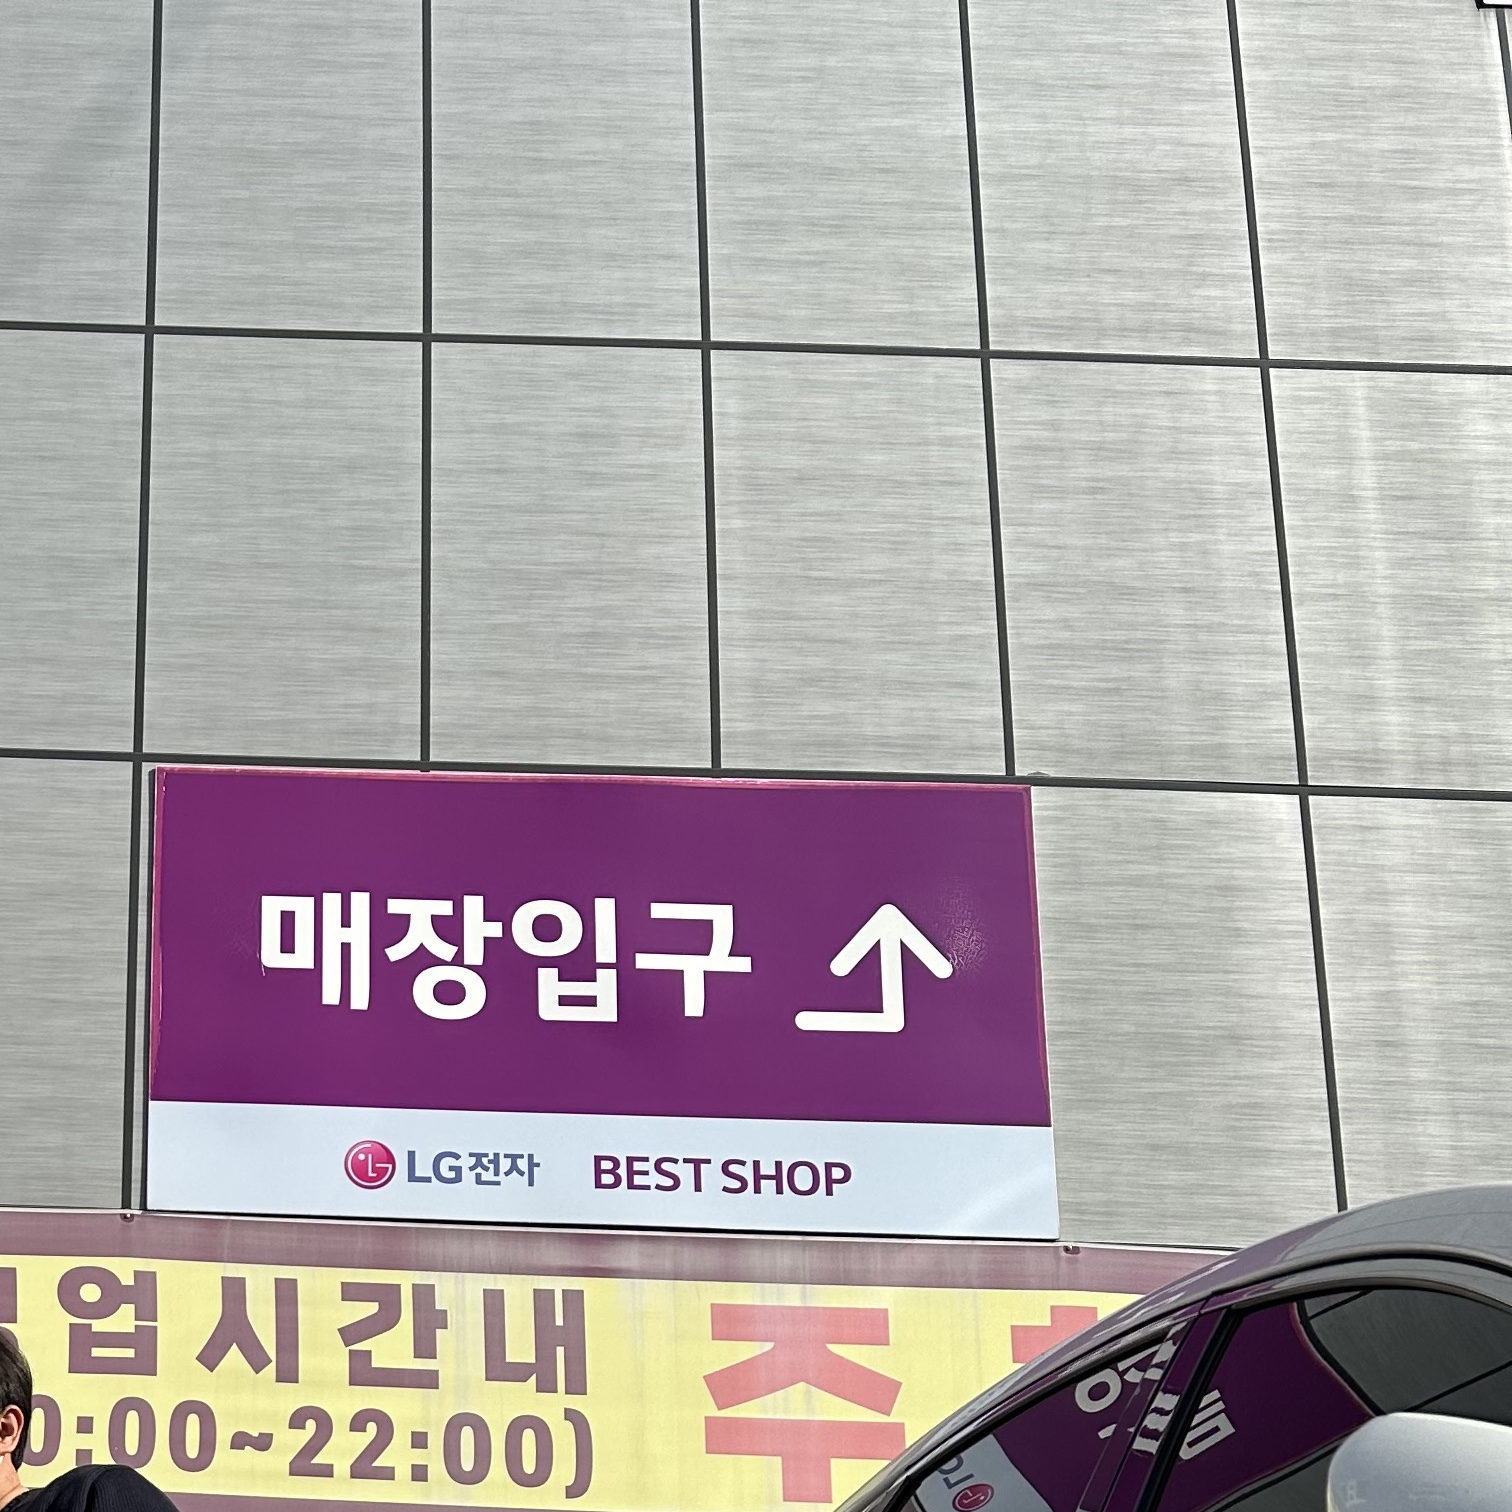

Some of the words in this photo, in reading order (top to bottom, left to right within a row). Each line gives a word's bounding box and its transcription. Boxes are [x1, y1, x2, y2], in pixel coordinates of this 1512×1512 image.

[259, 890, 753, 1024] 매장입구
[406, 1149, 540, 1187] LG전자
[592, 1154, 711, 1193] BEST
[721, 1157, 852, 1197] SHOP
[21, 1393, 595, 1500] 0:00~22:00)
